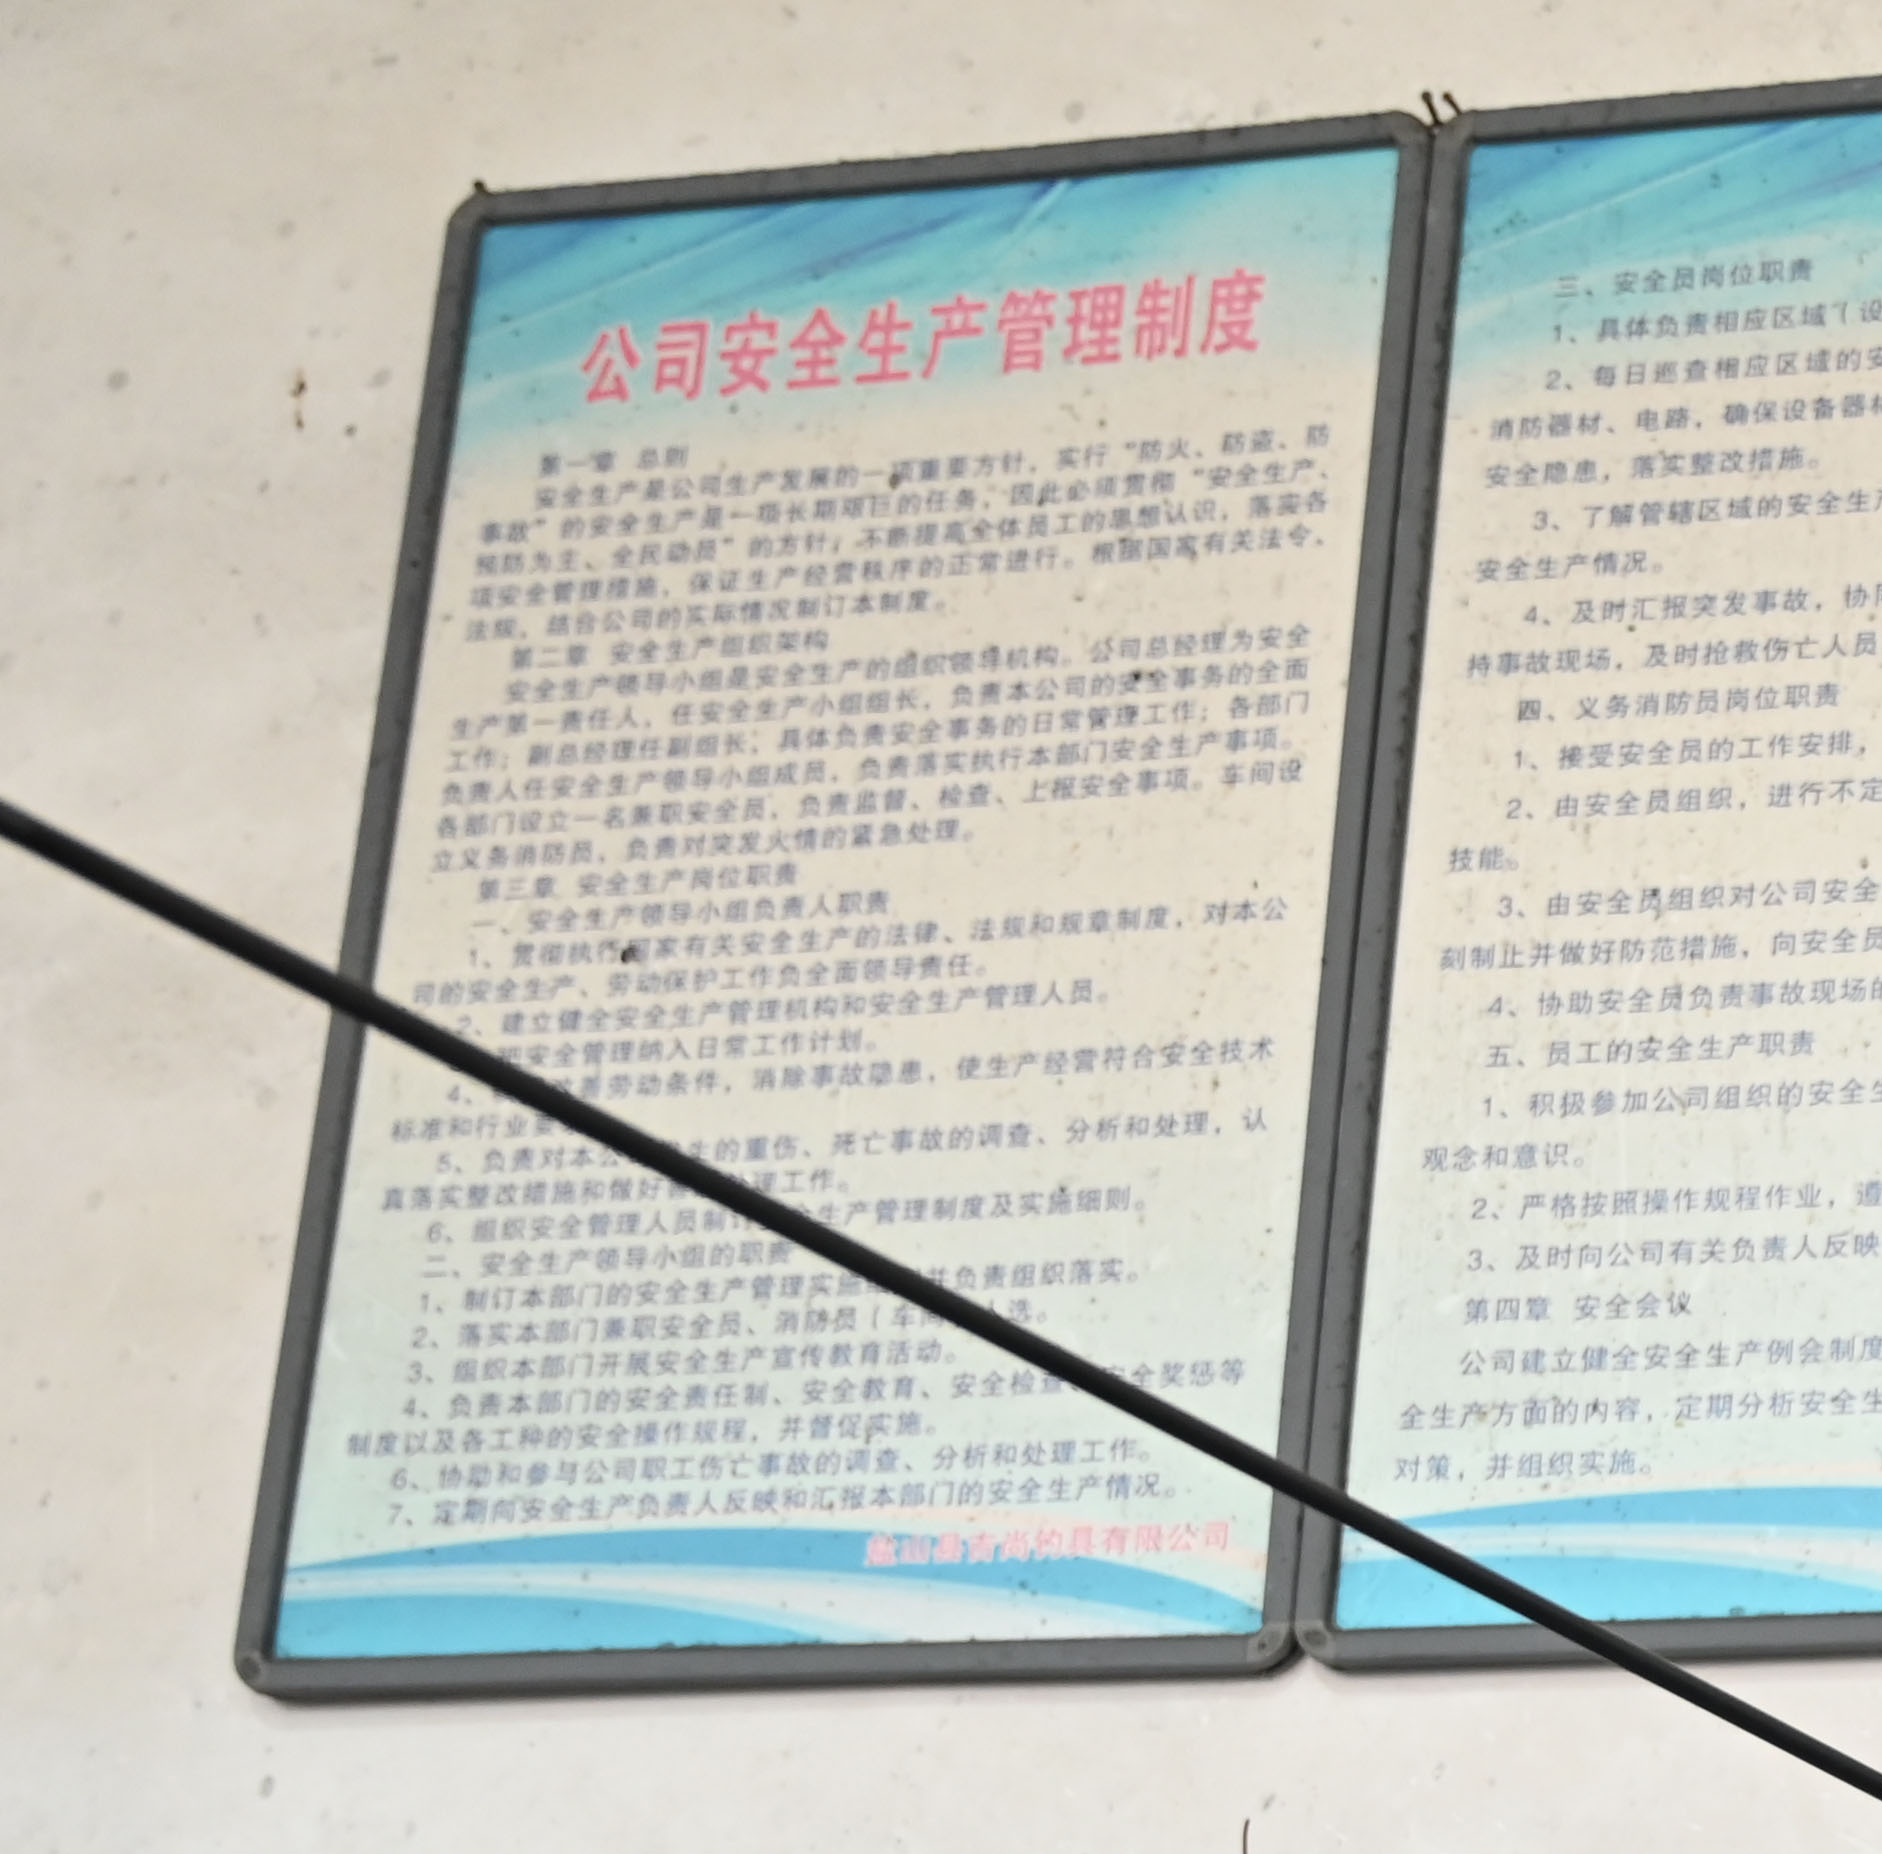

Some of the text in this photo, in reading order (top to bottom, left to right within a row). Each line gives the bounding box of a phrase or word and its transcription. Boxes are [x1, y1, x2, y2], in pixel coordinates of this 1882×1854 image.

[1555, 256, 1812, 302] 三、安全员岗位职责
[578, 268, 1265, 410] 公司安全生产管理制度
[538, 447, 614, 479] 第一章
[1483, 442, 1822, 490] 安全隐患，落实整改措施。
[1475, 546, 1667, 584] 安全生产情况。
[509, 624, 829, 672] 第二章 安全生产组织架构
[1515, 679, 1840, 726] 四、义务消防员岗位职责
[1447, 841, 1523, 874] 技能。
[476, 858, 797, 904] 第三章 安全生产岗位职责
[471, 887, 889, 939] 一、安全生产领导小组负责人职责
[446, 1035, 1274, 1109] 4、善劳动条件，消除事故隐患，使生产经营符合安全技术
[495, 1025, 884, 1073] 把安全管理纳入日常工作计划。
[1485, 1028, 1814, 1072] 五、员工的安全生产职责
[1421, 1138, 1588, 1174] 观念和意识。
[1463, 1288, 1692, 1327] 第四章 安全会议
[1394, 1446, 1654, 1485] 对策，并组织实施。
